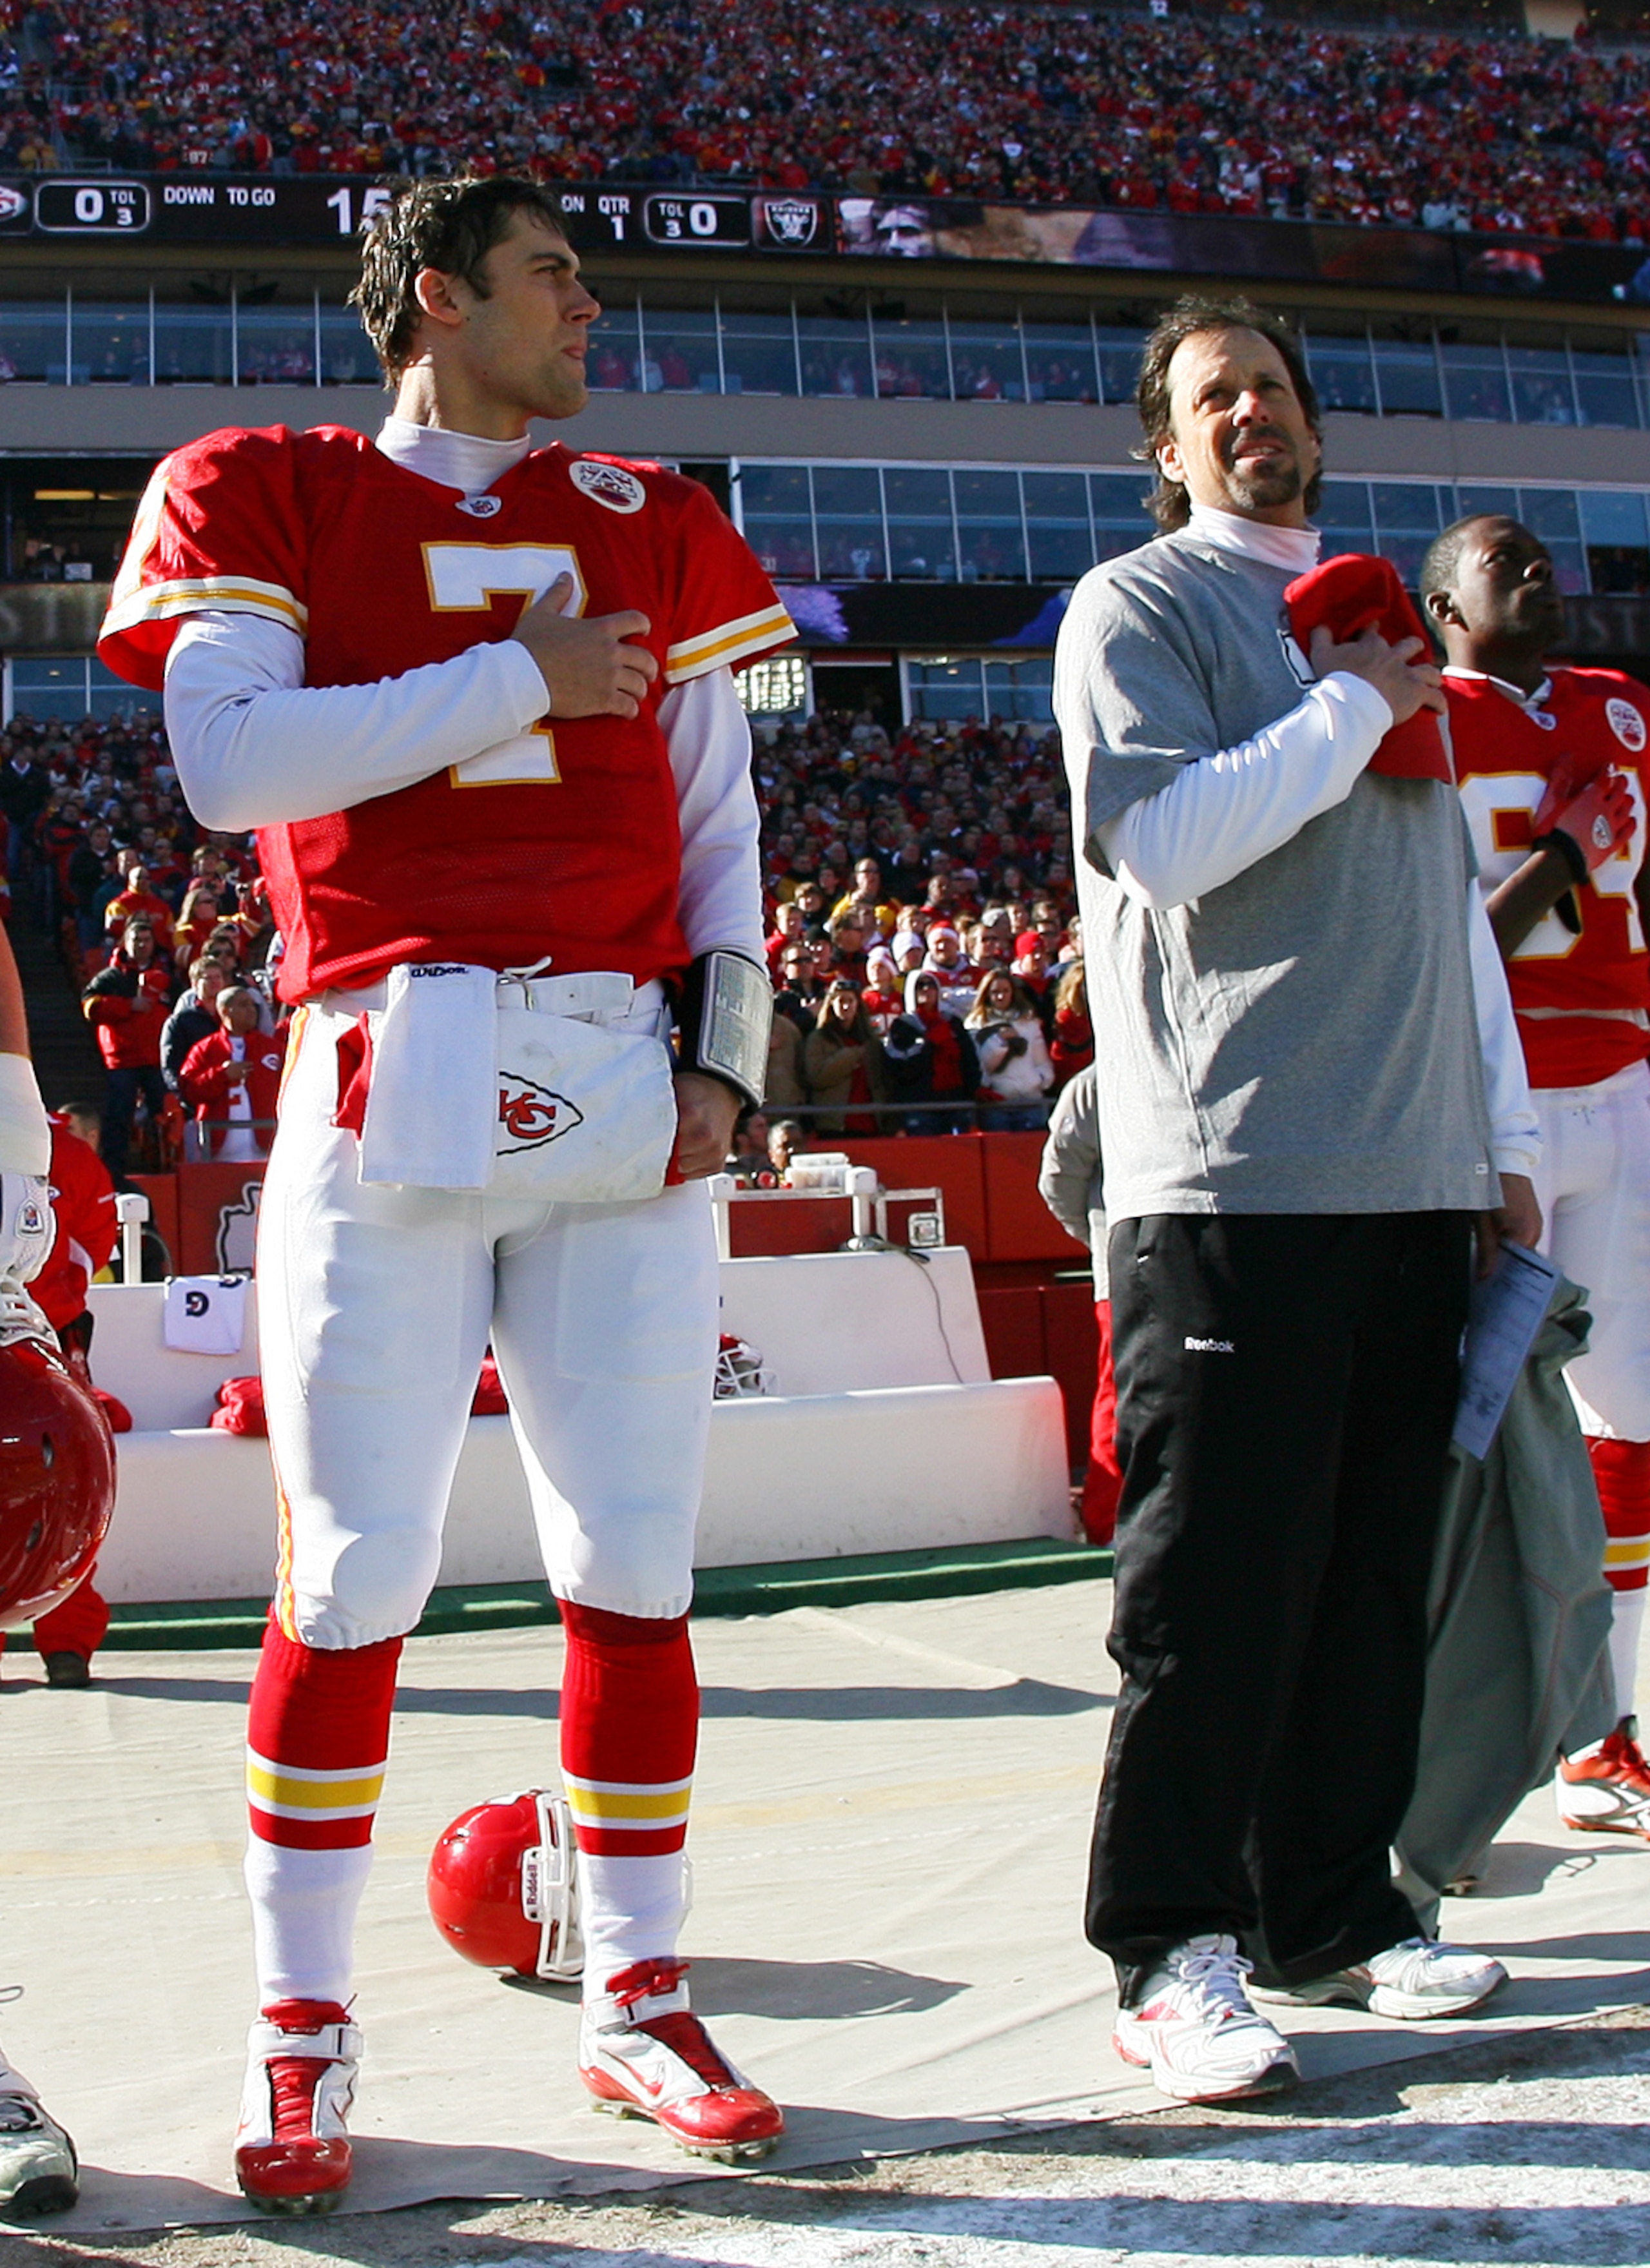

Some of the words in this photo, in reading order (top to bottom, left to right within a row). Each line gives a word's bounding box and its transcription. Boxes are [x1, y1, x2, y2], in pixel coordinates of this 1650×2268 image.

[75, 188, 104, 222] 0
[110, 190, 136, 205] TOL
[164, 186, 215, 205] DOWN
[226, 187, 249, 206] TO
[251, 187, 276, 206] GO
[561, 195, 585, 213] ON
[598, 196, 630, 215] QTR
[117, 208, 133, 226] 3
[659, 202, 684, 218] TOL
[690, 203, 717, 235] 0
[611, 216, 624, 240] 1
[666, 220, 681, 238] 3
[420, 540, 588, 788] 7
[499, 1090, 556, 1139] KC
[527, 1864, 538, 1905] Riddell
